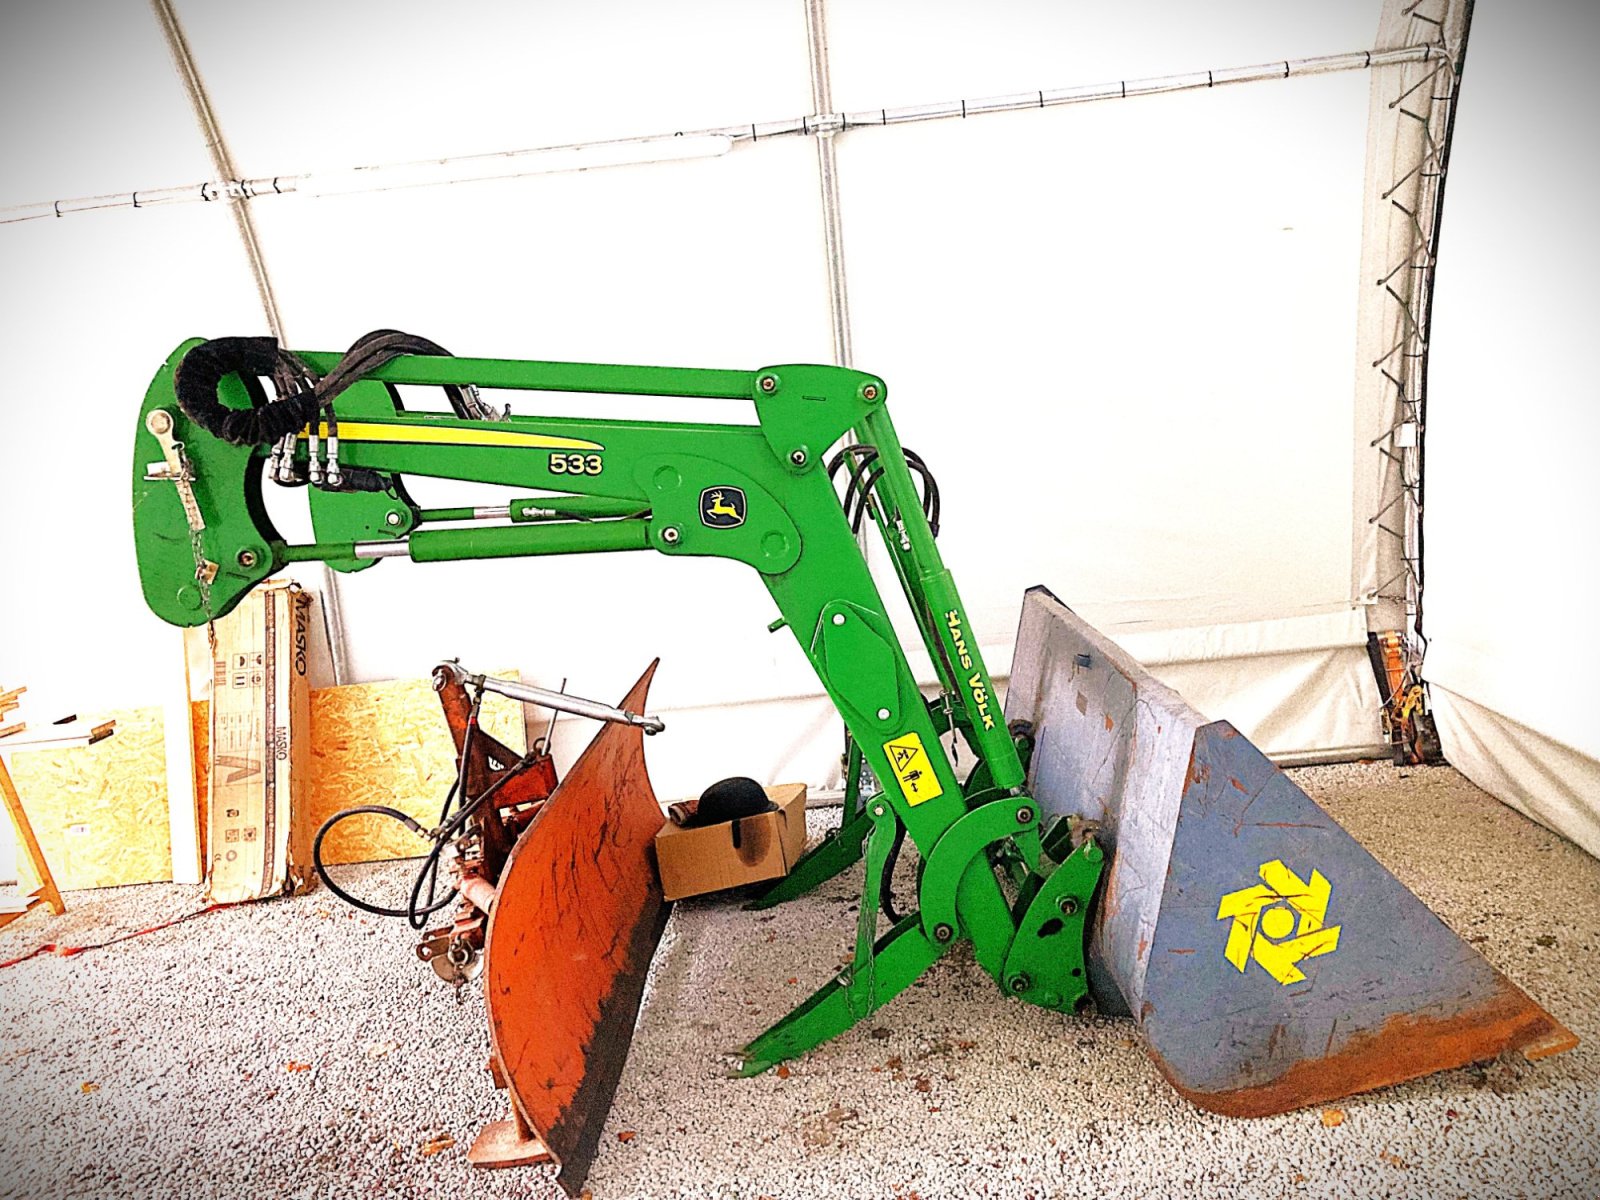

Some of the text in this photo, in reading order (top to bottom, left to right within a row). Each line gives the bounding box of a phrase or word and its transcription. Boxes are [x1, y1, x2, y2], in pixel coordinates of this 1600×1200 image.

[549, 453, 603, 476] 533
[295, 598, 307, 677] MASKO
[945, 609, 995, 731] HANS VÖLK
[275, 726, 288, 760] MASKO
